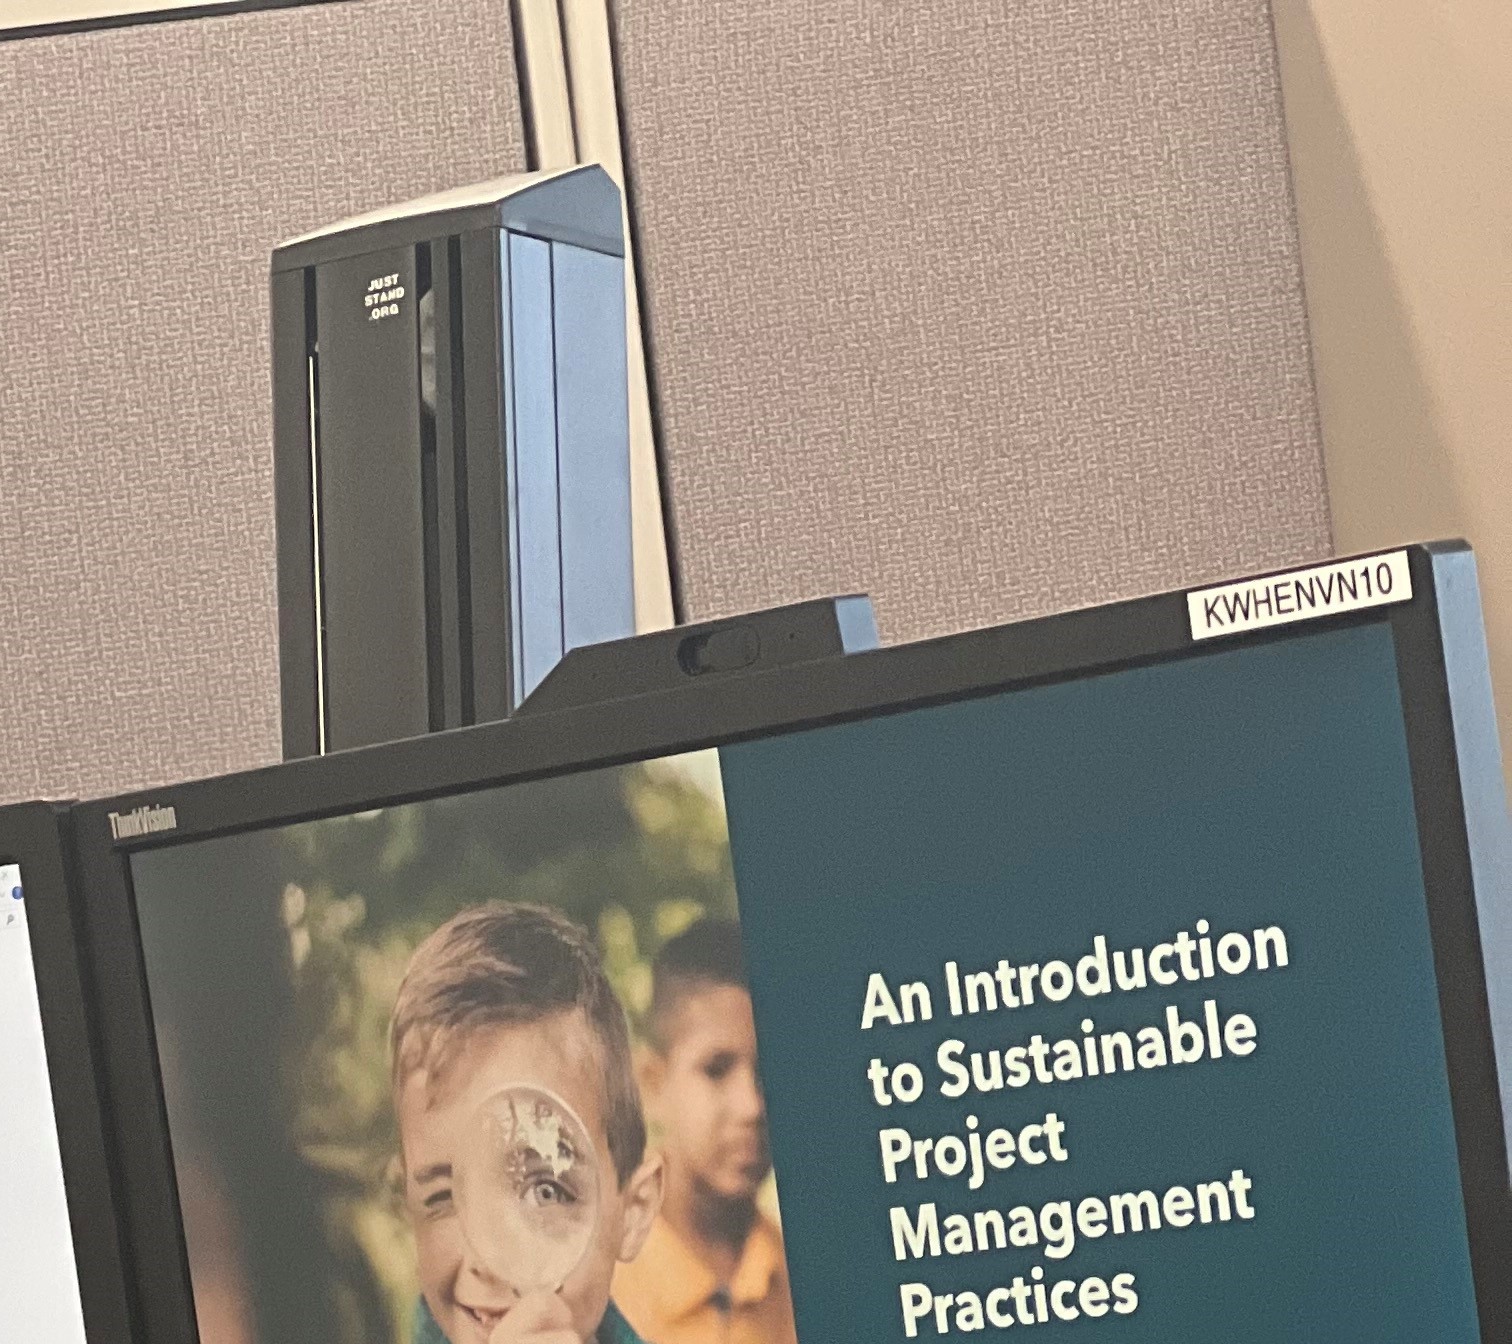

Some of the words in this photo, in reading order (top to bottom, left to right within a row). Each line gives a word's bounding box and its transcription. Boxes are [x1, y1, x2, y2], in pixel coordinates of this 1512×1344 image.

[364, 287, 405, 306] STAND
[368, 273, 399, 292] JUST
[369, 304, 399, 321] .ORG
[1204, 563, 1392, 628] KWHENVN10
[860, 973, 932, 1029] An
[945, 919, 1288, 1016] Introduction
[867, 1059, 924, 1107] to
[936, 999, 1257, 1097] Sustainable
[879, 1113, 1068, 1190] Project
[889, 1169, 1255, 1261] Management
[900, 1266, 1139, 1337] Practices
